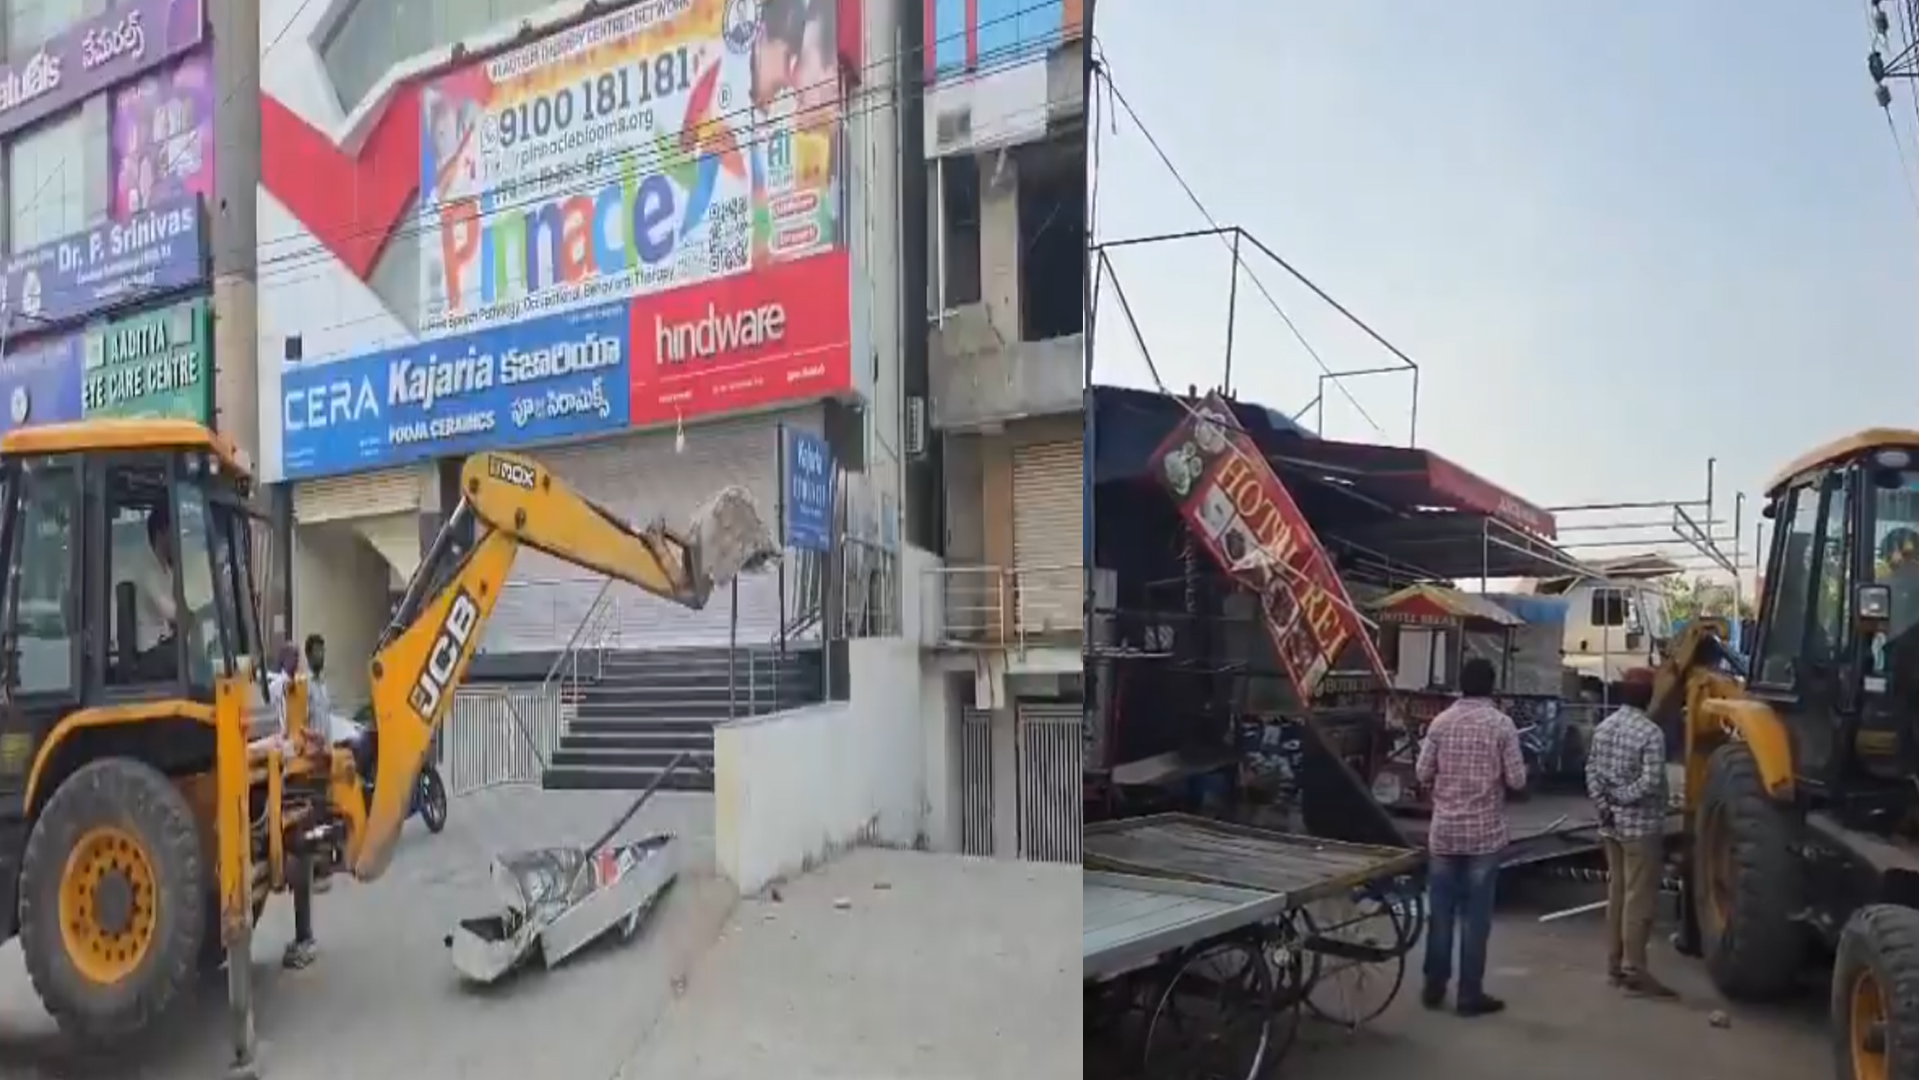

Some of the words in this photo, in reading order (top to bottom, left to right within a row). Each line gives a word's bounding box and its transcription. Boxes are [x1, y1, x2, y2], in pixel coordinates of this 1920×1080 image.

[500, 93, 573, 147] 9100
[583, 69, 635, 121] 181
[640, 47, 690, 99] 181
[59, 242, 82, 274] Dr.
[89, 234, 104, 260] P.
[110, 206, 194, 255] Srinivas
[442, 156, 677, 312] Pinnacle
[111, 320, 165, 364] AADITYA
[655, 302, 786, 365] hindware
[83, 373, 105, 410] EYE
[110, 365, 144, 403] CARE
[148, 351, 199, 396] CENTRE
[285, 376, 380, 431] CERA
[388, 346, 494, 408] Kajaria
[429, 410, 495, 440] CERAMICS
[411, 593, 479, 721] JCB
